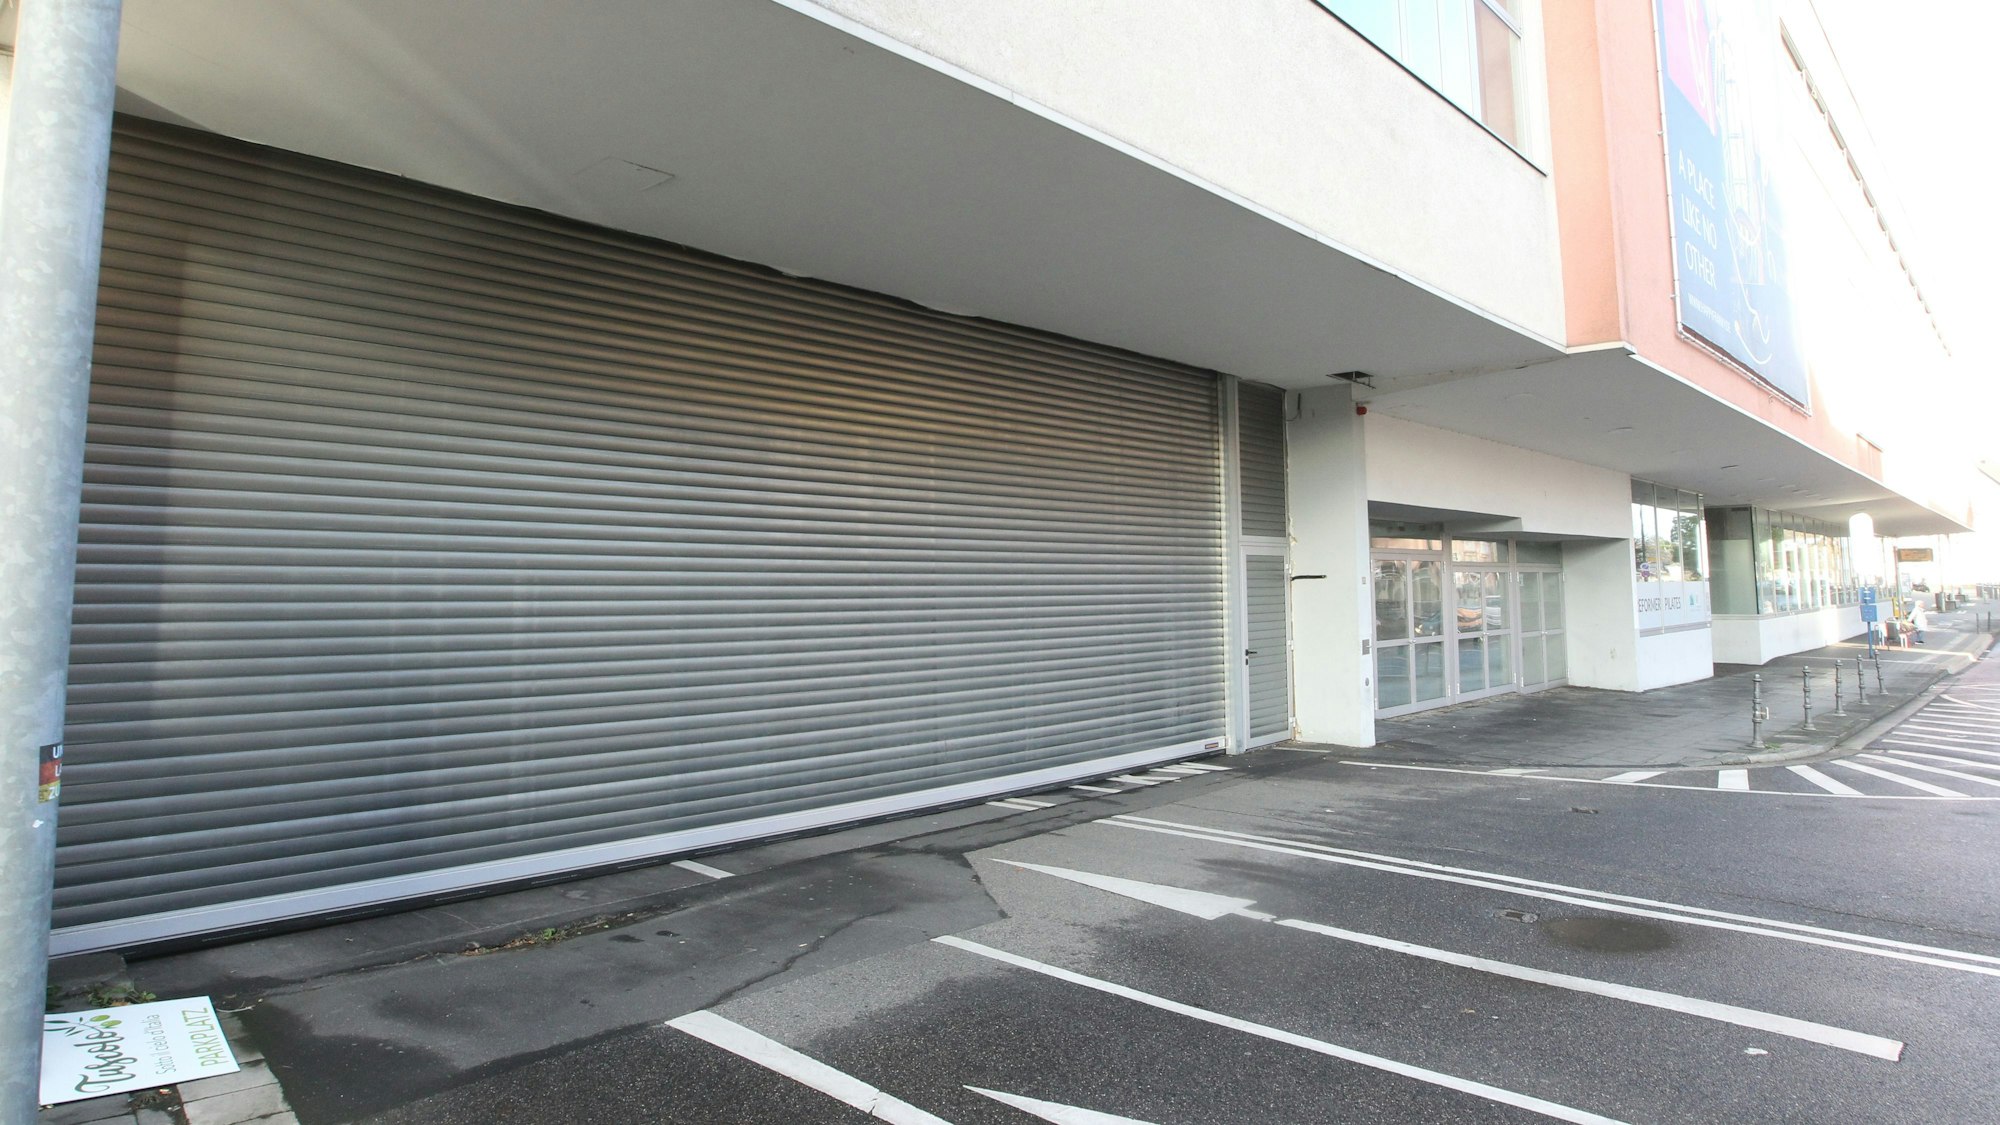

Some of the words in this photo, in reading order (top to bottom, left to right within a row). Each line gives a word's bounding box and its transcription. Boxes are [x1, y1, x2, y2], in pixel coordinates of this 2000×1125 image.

[1678, 149, 1686, 180] A
[1687, 159, 1716, 211] PLACE
[1681, 193, 1702, 236] LIKE
[1702, 214, 1717, 250] NO
[1685, 240, 1717, 290] OTHER
[1638, 597, 1661, 612] EFORMER
[1664, 597, 1681, 610] PILATES
[74, 1031, 137, 1093] Tuscolo
[145, 1036, 169, 1051] cielo
[181, 1007, 231, 1067] PARKPLATZ
[154, 1055, 177, 1075] Sotto
